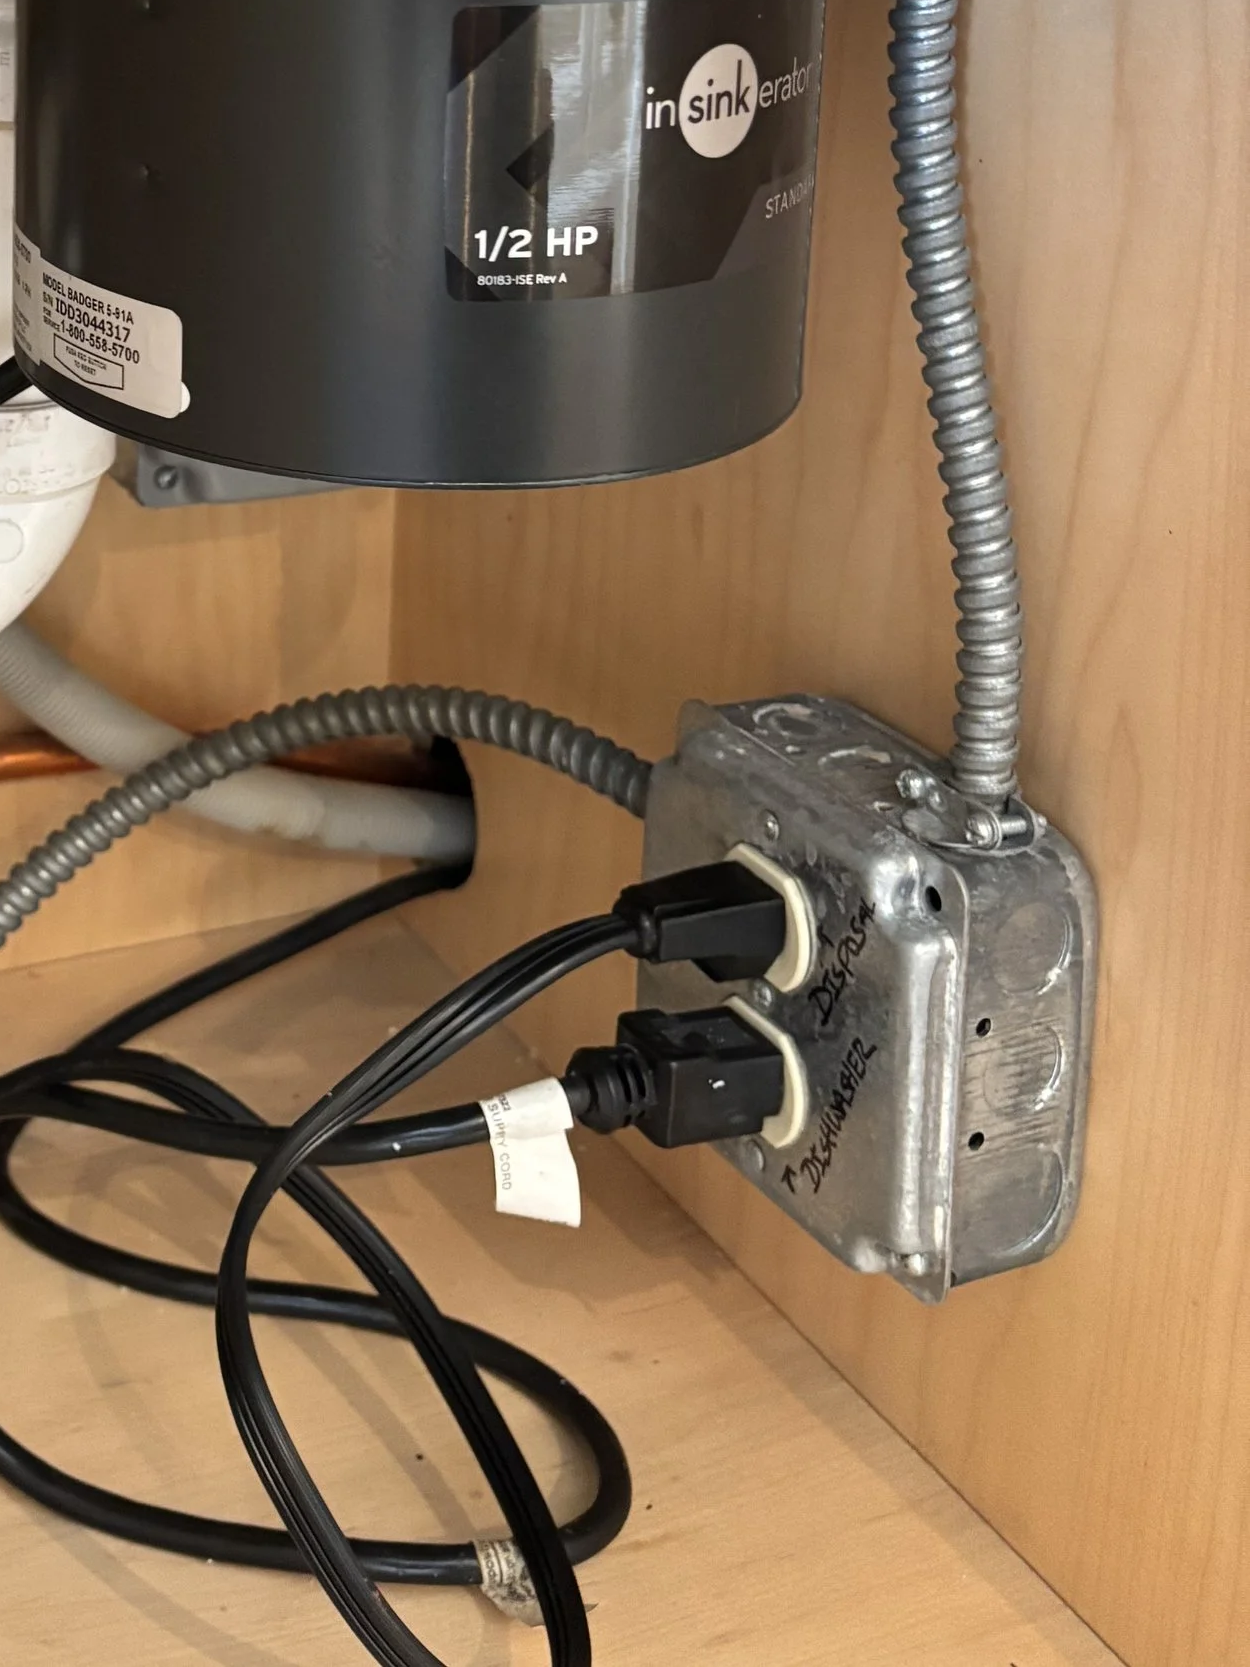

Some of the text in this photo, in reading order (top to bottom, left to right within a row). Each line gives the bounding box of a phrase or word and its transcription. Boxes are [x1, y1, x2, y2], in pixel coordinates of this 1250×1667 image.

[474, 226, 599, 262] 1/2 HP
[42, 271, 67, 297] MODEL
[67, 286, 105, 314] BADGER
[477, 272, 568, 286] 80183-ISE Rev A
[55, 297, 131, 343] IDD3044317
[61, 319, 141, 364] 1-800-558-5700
[808, 898, 877, 1027] DISPOSAL
[800, 1036, 878, 1194] DISHWASHER
